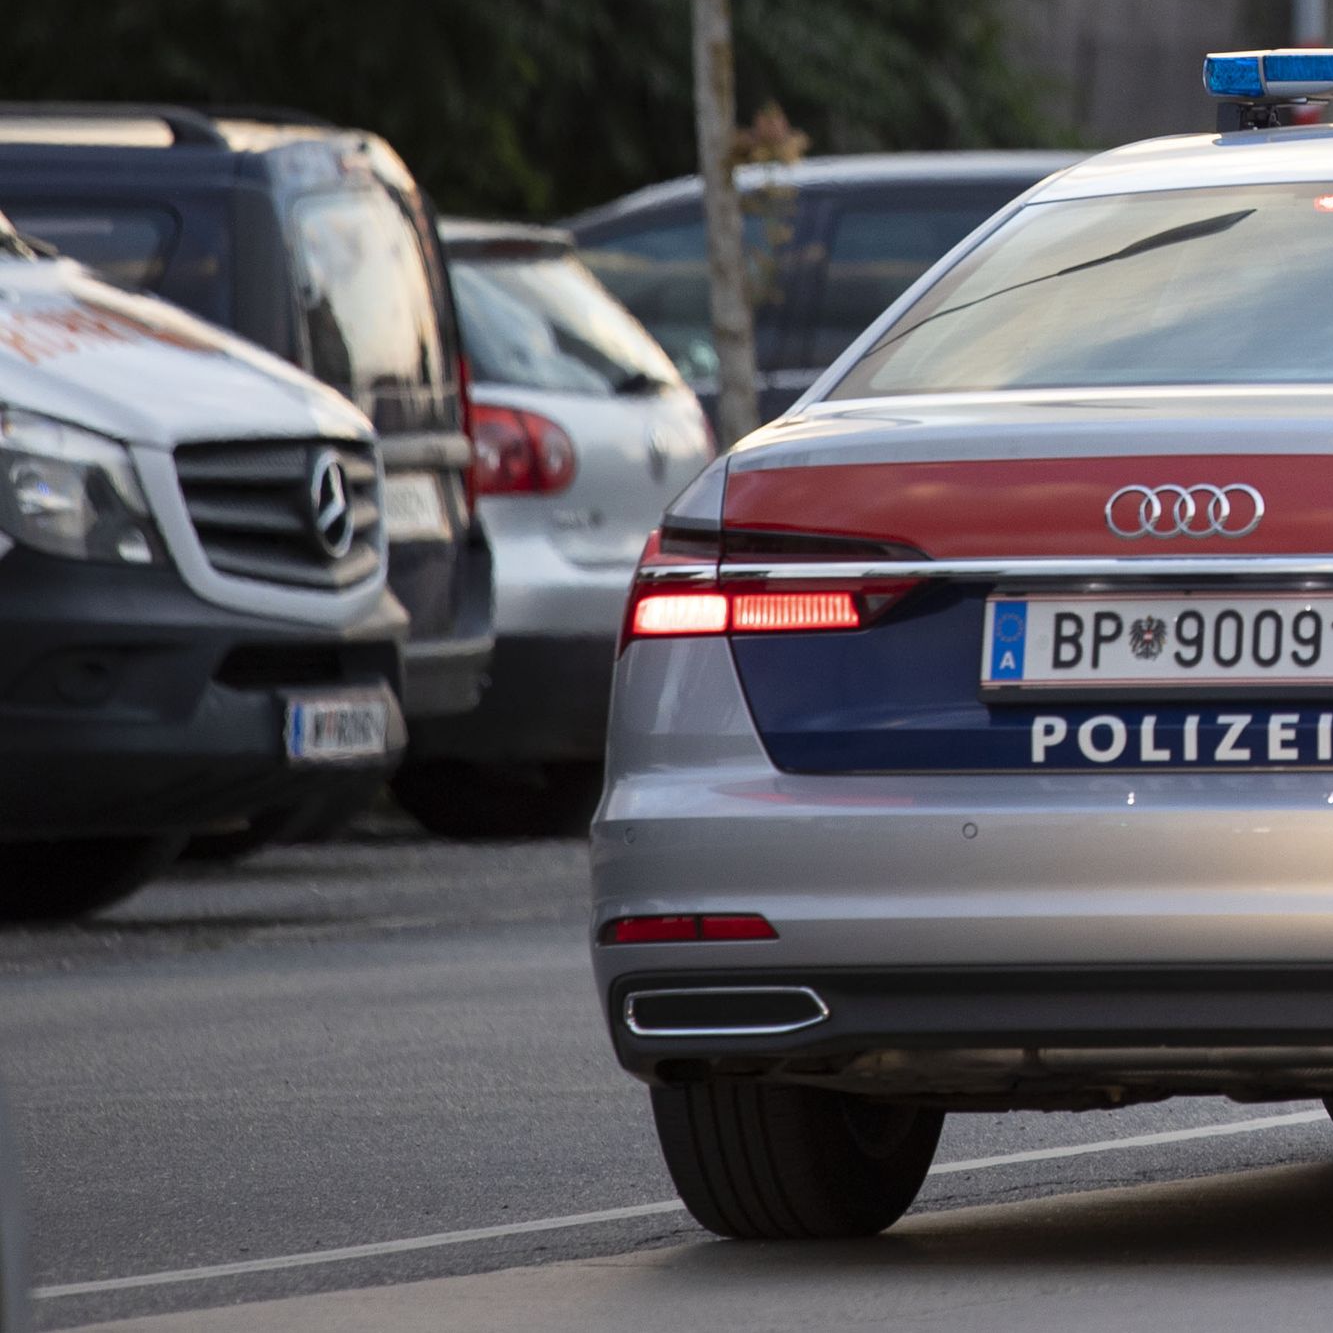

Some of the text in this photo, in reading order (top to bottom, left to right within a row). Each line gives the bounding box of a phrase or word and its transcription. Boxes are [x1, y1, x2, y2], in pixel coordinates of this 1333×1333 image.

[999, 650, 1017, 670] A
[1052, 611, 1123, 669] BP
[1031, 713, 1333, 763] POLIZEI
